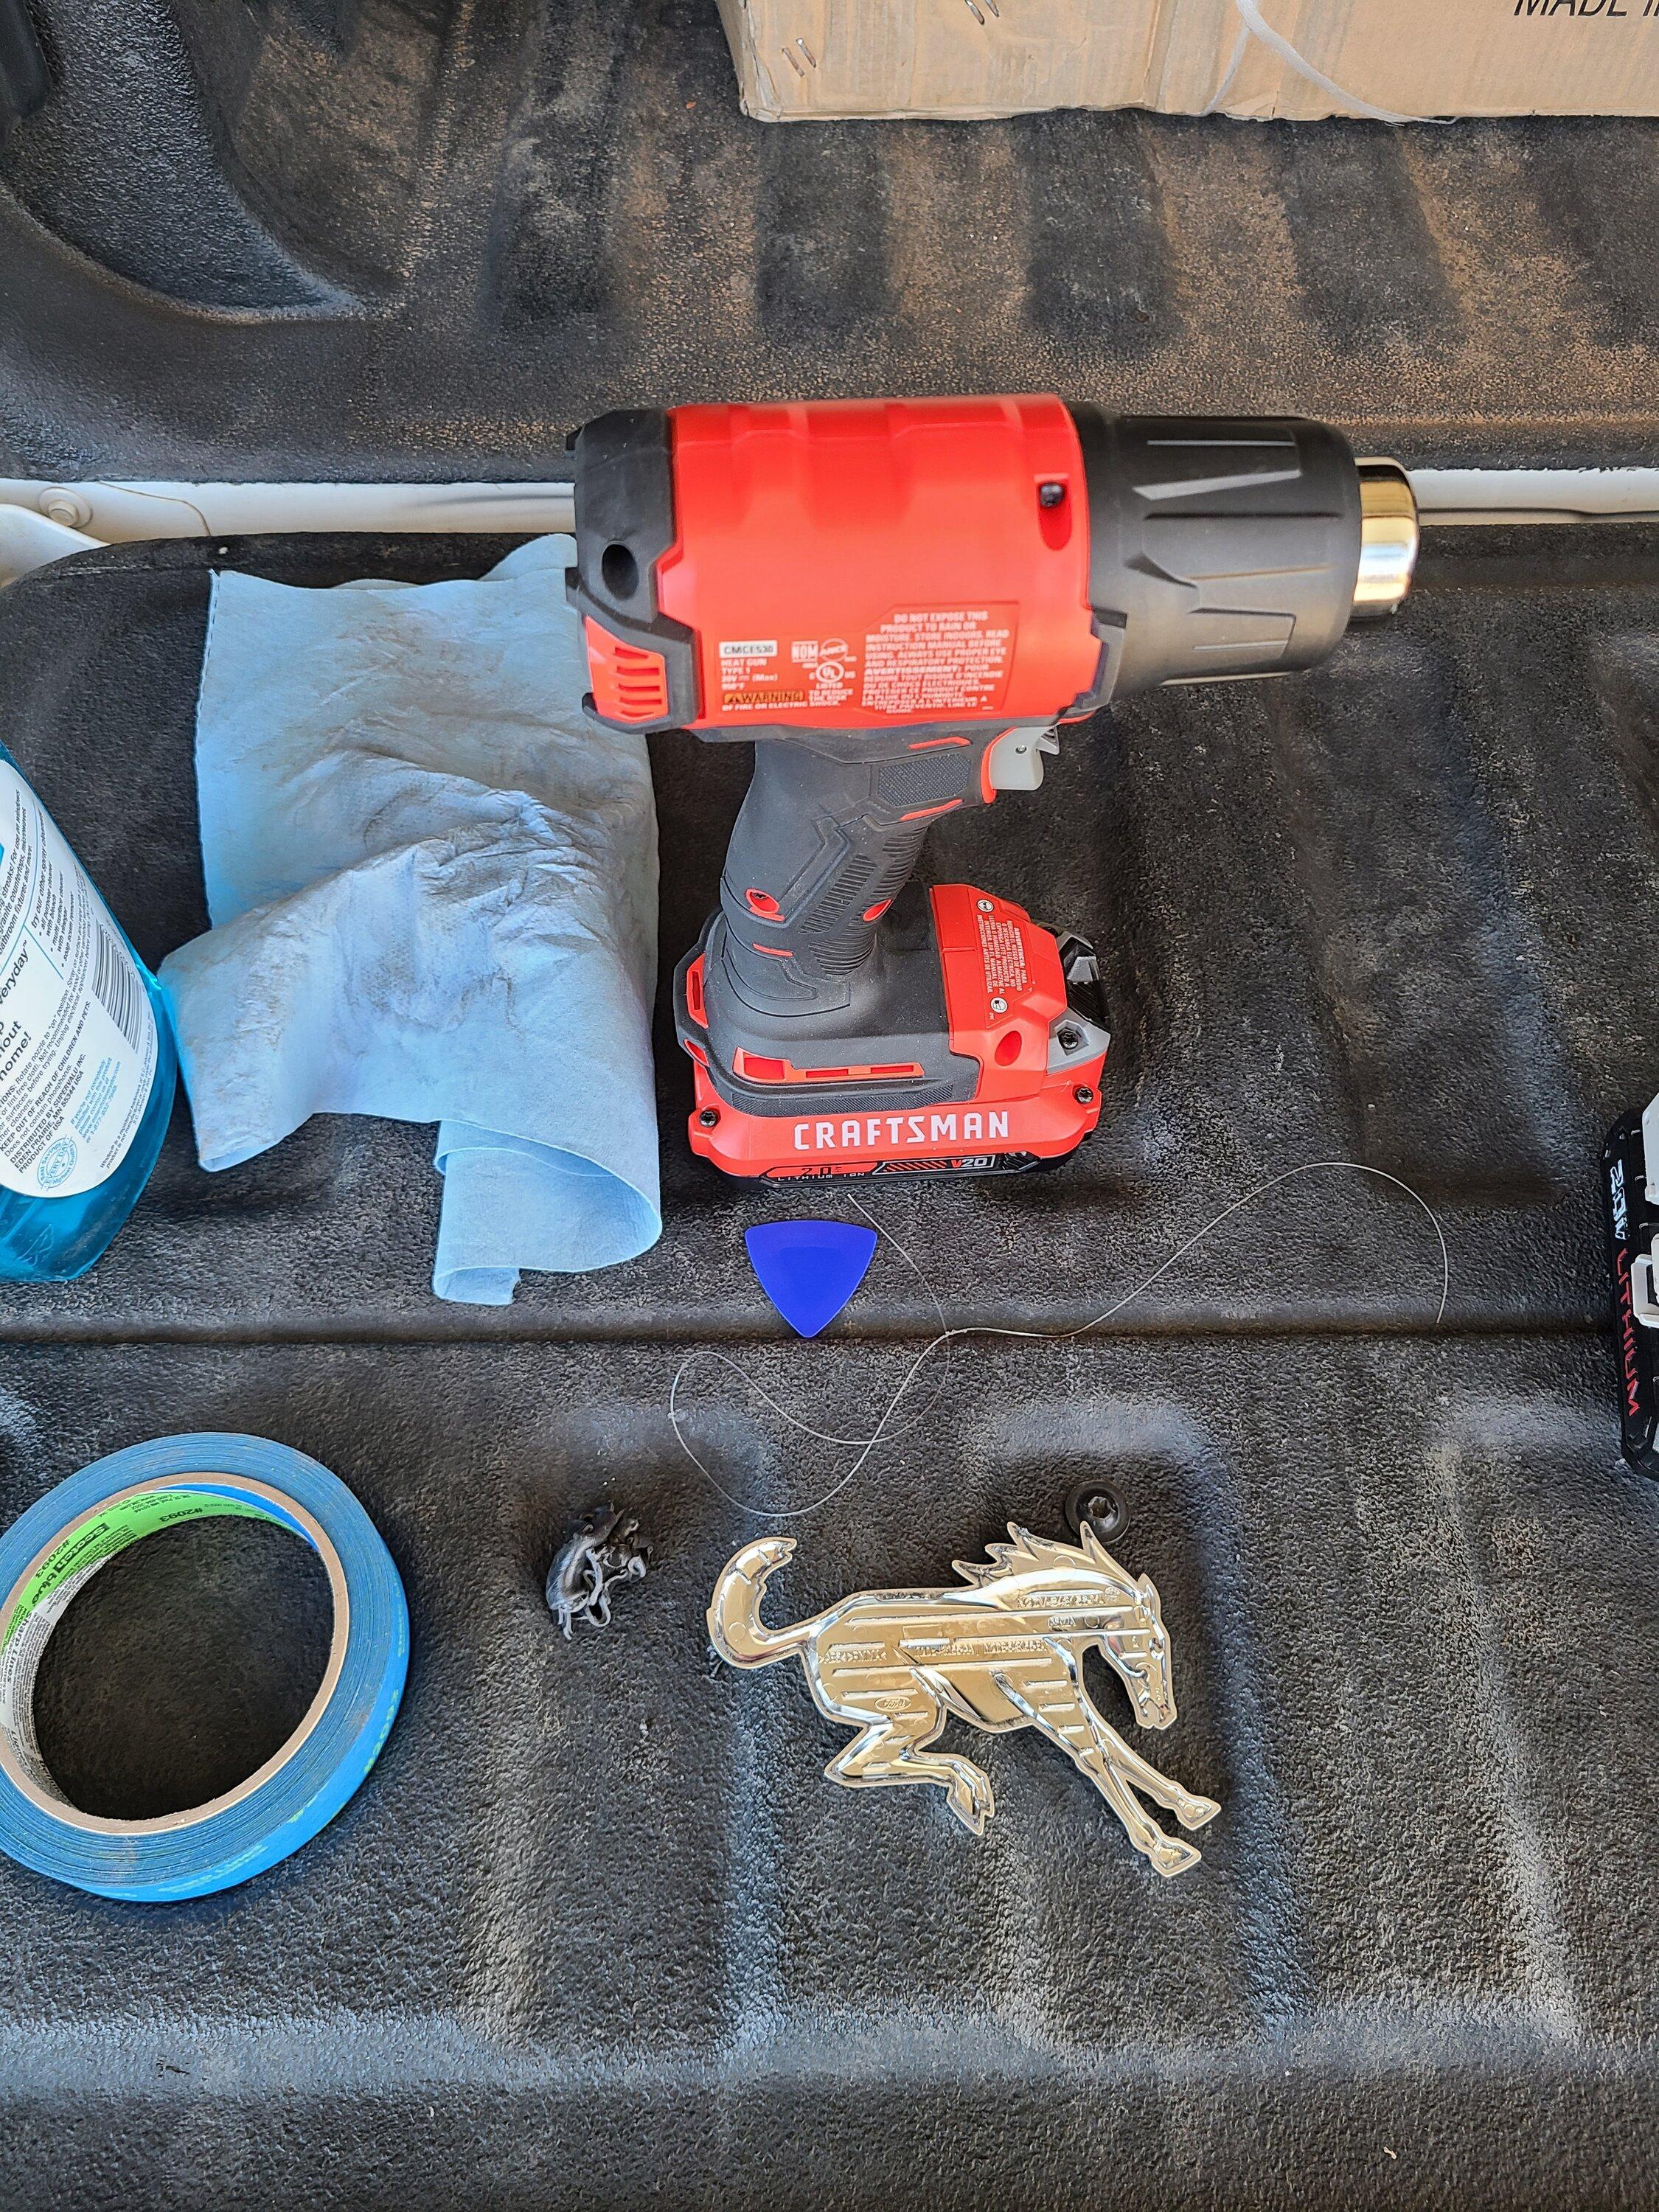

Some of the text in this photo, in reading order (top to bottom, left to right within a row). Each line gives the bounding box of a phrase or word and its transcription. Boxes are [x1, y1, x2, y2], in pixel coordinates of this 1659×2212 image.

[742, 691, 801, 701] WARNING
[31, 913, 40, 928] try
[15, 1062, 32, 1084] Rotate
[31, 1040, 46, 1062] nozzle
[44, 1032, 50, 1040] to
[57, 990, 69, 1017] position.
[67, 968, 75, 988] Spray
[6, 1093, 28, 1121] surfaces
[27, 1071, 44, 1093] before
[42, 1050, 57, 1070] trying.
[55, 1024, 69, 1048] Unplug
[67, 991, 80, 1023] electrical
[7, 1095, 18, 1107] lint
[16, 1081, 28, 1096] free
[27, 1064, 41, 1081] cloth.
[38, 1048, 48, 1062] Not
[46, 1002, 71, 1049] recommended
[0, 1001, 91, 1152] KEEP OUT OF REACH OF CHILDREN AND PETS.
[4, 1065, 72, 1157] Does not contain phosphorus.
[10, 1054, 86, 1164] DISTRIBUTED BY SUPERVALU INC.
[10, 1099, 34, 1127] cleaners.
[14, 1071, 84, 1169] EDEN PRAIRIE, MN 55344 USA
[794, 1111, 1009, 1150] CRAFTSMAN
[19, 1116, 65, 1173] PRODUCT OF USA
[950, 1157, 988, 1169] V20
[1615, 1247, 1640, 1416] LITHIUM
[159, 1506, 201, 1522] #2093
[34, 1538, 70, 1579] #2093
[55, 1525, 105, 1570] Scotch
[30, 1571, 58, 1604] blue
[13, 1610, 32, 1646] Sharp
[7, 1649, 18, 1683] Lines
